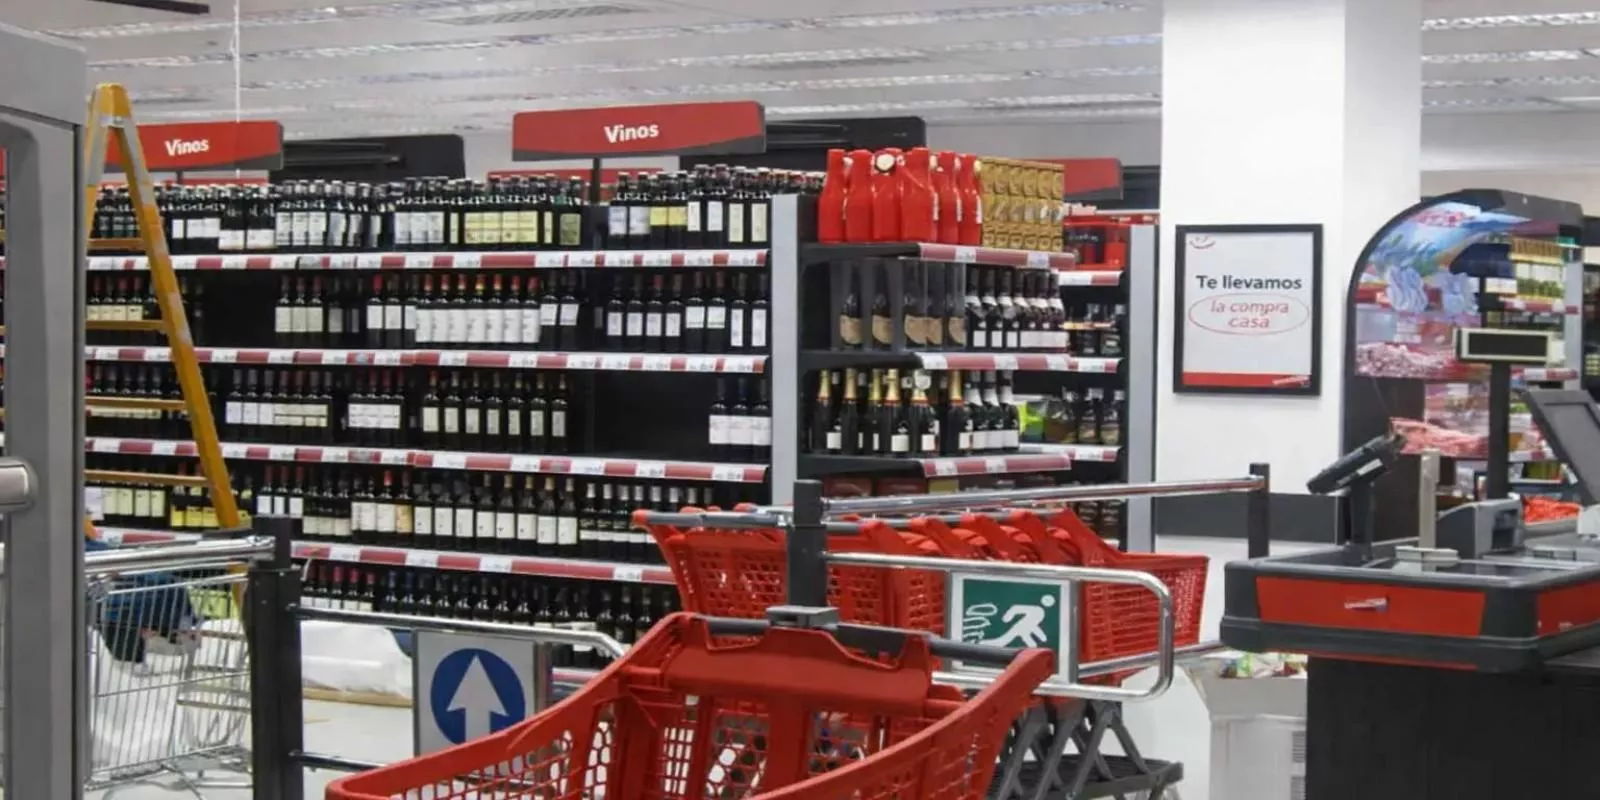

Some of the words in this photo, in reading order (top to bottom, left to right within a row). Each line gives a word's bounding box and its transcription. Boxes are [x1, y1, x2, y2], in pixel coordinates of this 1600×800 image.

[604, 124, 659, 143] Vinos
[165, 139, 209, 156] Vinos
[1195, 275, 1217, 289] Te
[1222, 275, 1302, 290] llevamos
[1210, 300, 1225, 313] la
[1230, 302, 1289, 316] compra
[1228, 317, 1270, 328] casa
